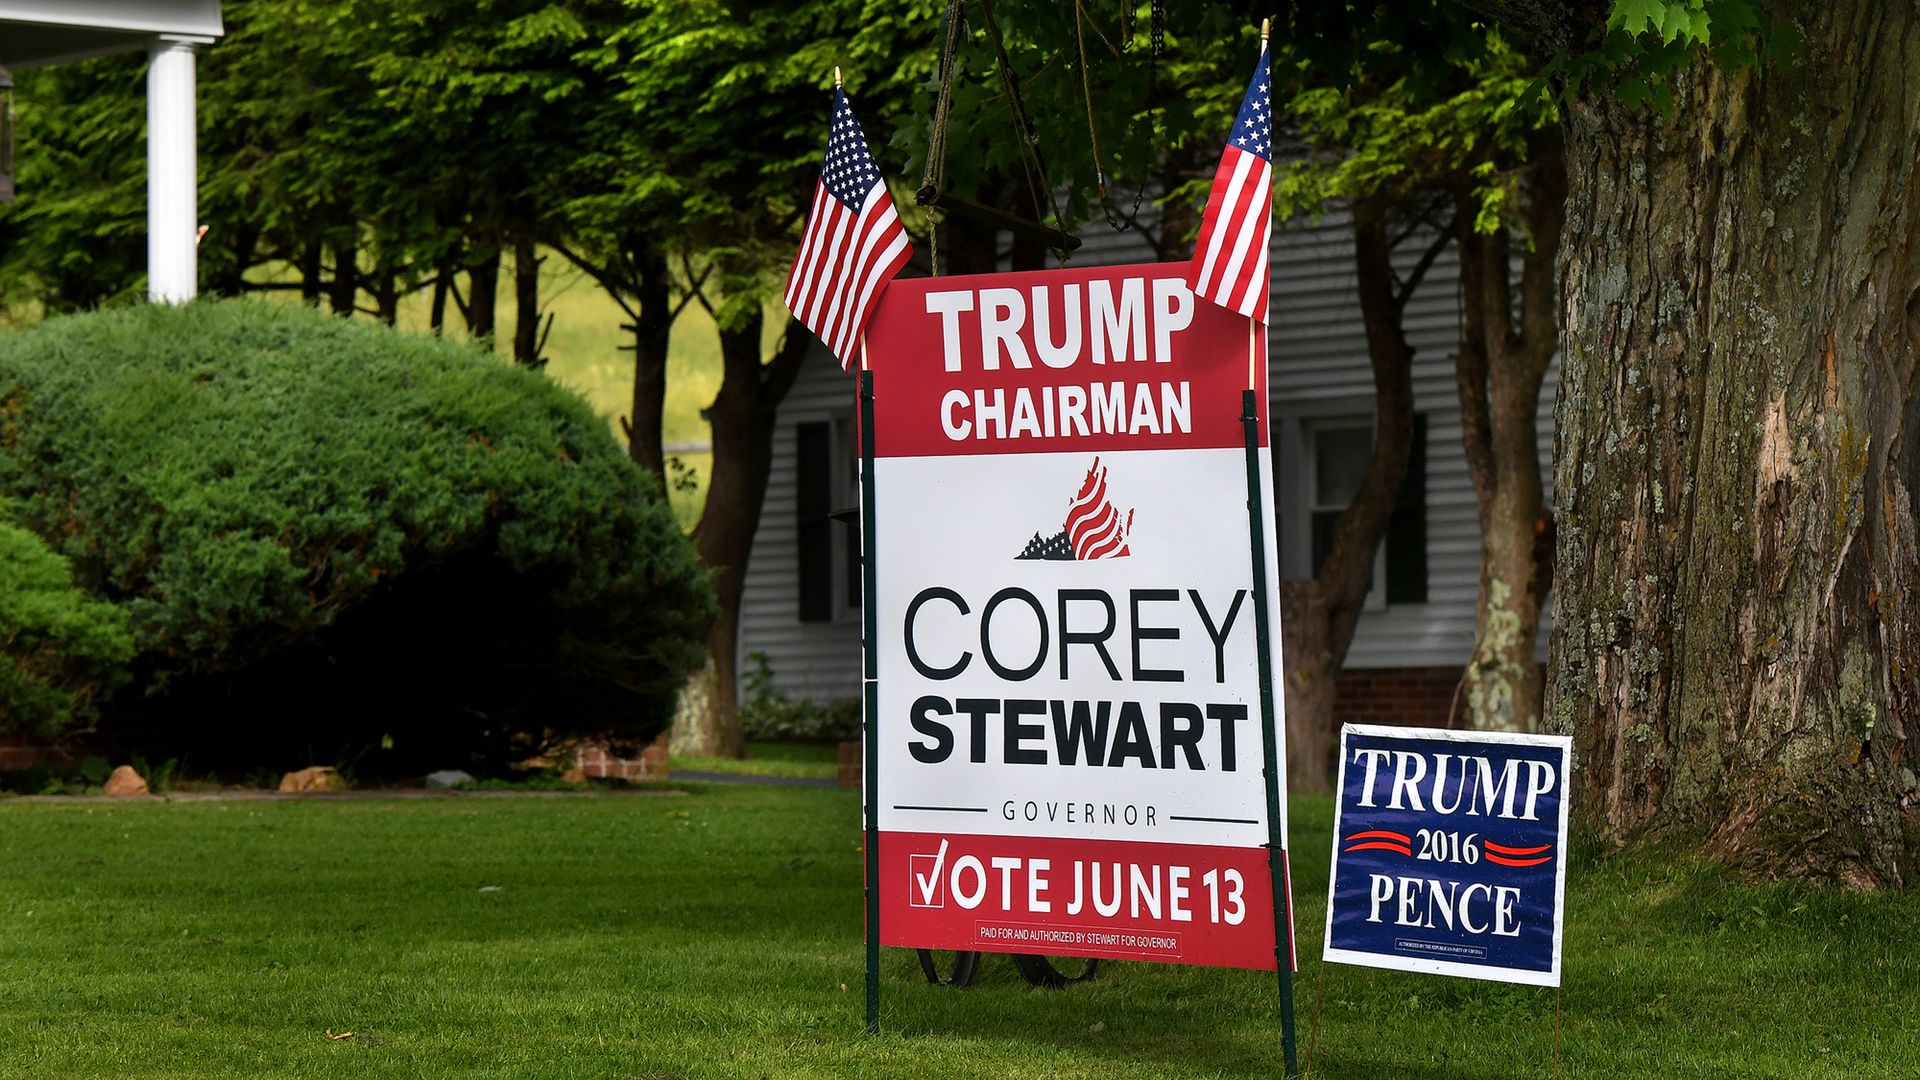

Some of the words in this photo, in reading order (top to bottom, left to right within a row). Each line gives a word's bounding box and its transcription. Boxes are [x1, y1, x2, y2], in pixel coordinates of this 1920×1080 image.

[925, 277, 1195, 372] TRUMP
[941, 381, 1192, 441] CHAIRMAN
[904, 586, 1247, 683] COREY
[908, 695, 1248, 772] STEWART
[1002, 800, 1157, 826] GOVERNOR
[1353, 748, 1556, 821] TRUMP
[1416, 828, 1479, 865] 2016
[1067, 860, 1193, 921] JUNE
[1202, 868, 1246, 926] 13
[1366, 873, 1522, 937] PENCE
[980, 927, 997, 938] PAID
[998, 928, 1013, 939] FOR
[1013, 929, 1029, 940] AND
[1029, 930, 1074, 943] AUTHORIZED
[1076, 932, 1085, 943] BY
[1087, 933, 1120, 946] STEWART
[1121, 935, 1136, 947] FOR
[1137, 936, 1177, 949] GOVERNOR
